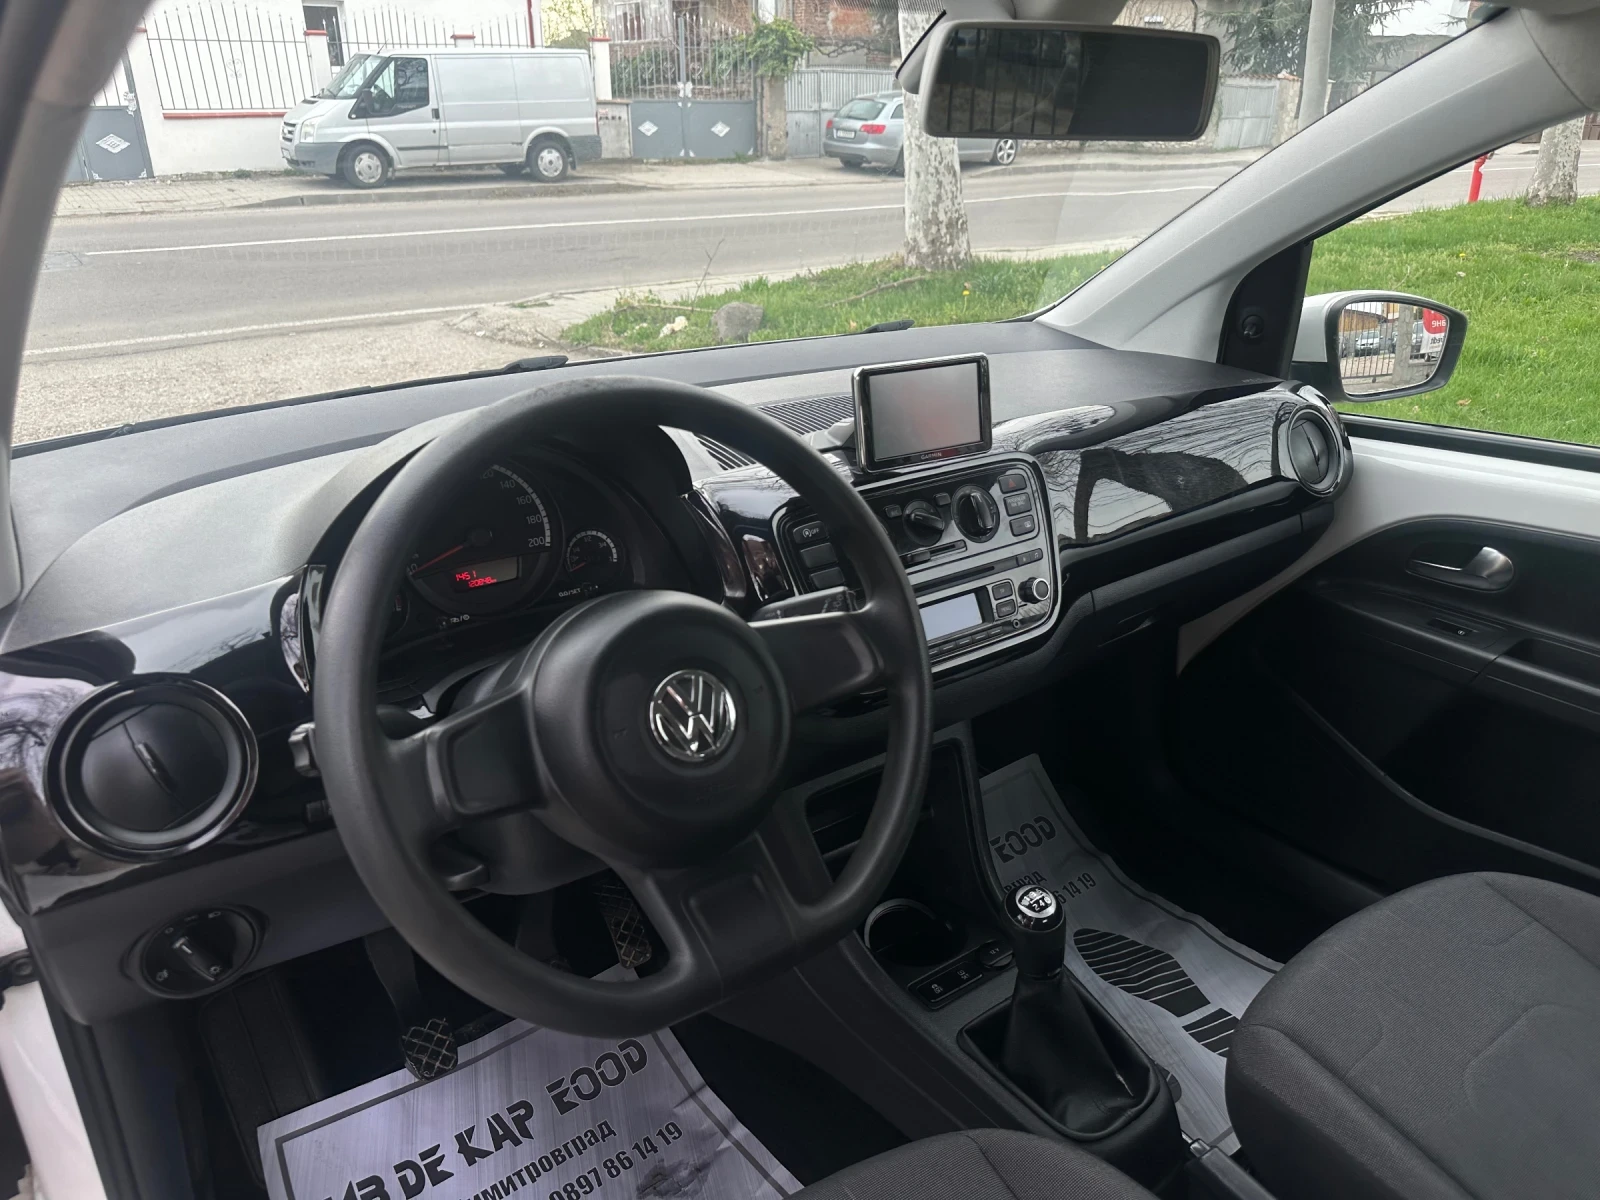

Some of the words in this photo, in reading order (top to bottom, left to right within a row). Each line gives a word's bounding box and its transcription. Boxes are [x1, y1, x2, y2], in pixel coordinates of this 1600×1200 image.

[920, 451, 942, 459] GARMIN
[499, 480, 516, 489] 140
[516, 495, 532, 506] 160
[526, 514, 542, 524] 180
[528, 537, 544, 548] 200
[1062, 880, 1082, 898] 14
[1078, 872, 1096, 890] 19
[393, 1143, 455, 1200] DE
[454, 1100, 535, 1167] KAP
[545, 1038, 648, 1116] EOOD
[602, 1150, 634, 1179] 86
[632, 1136, 659, 1160] 14
[656, 1121, 683, 1146] 19
